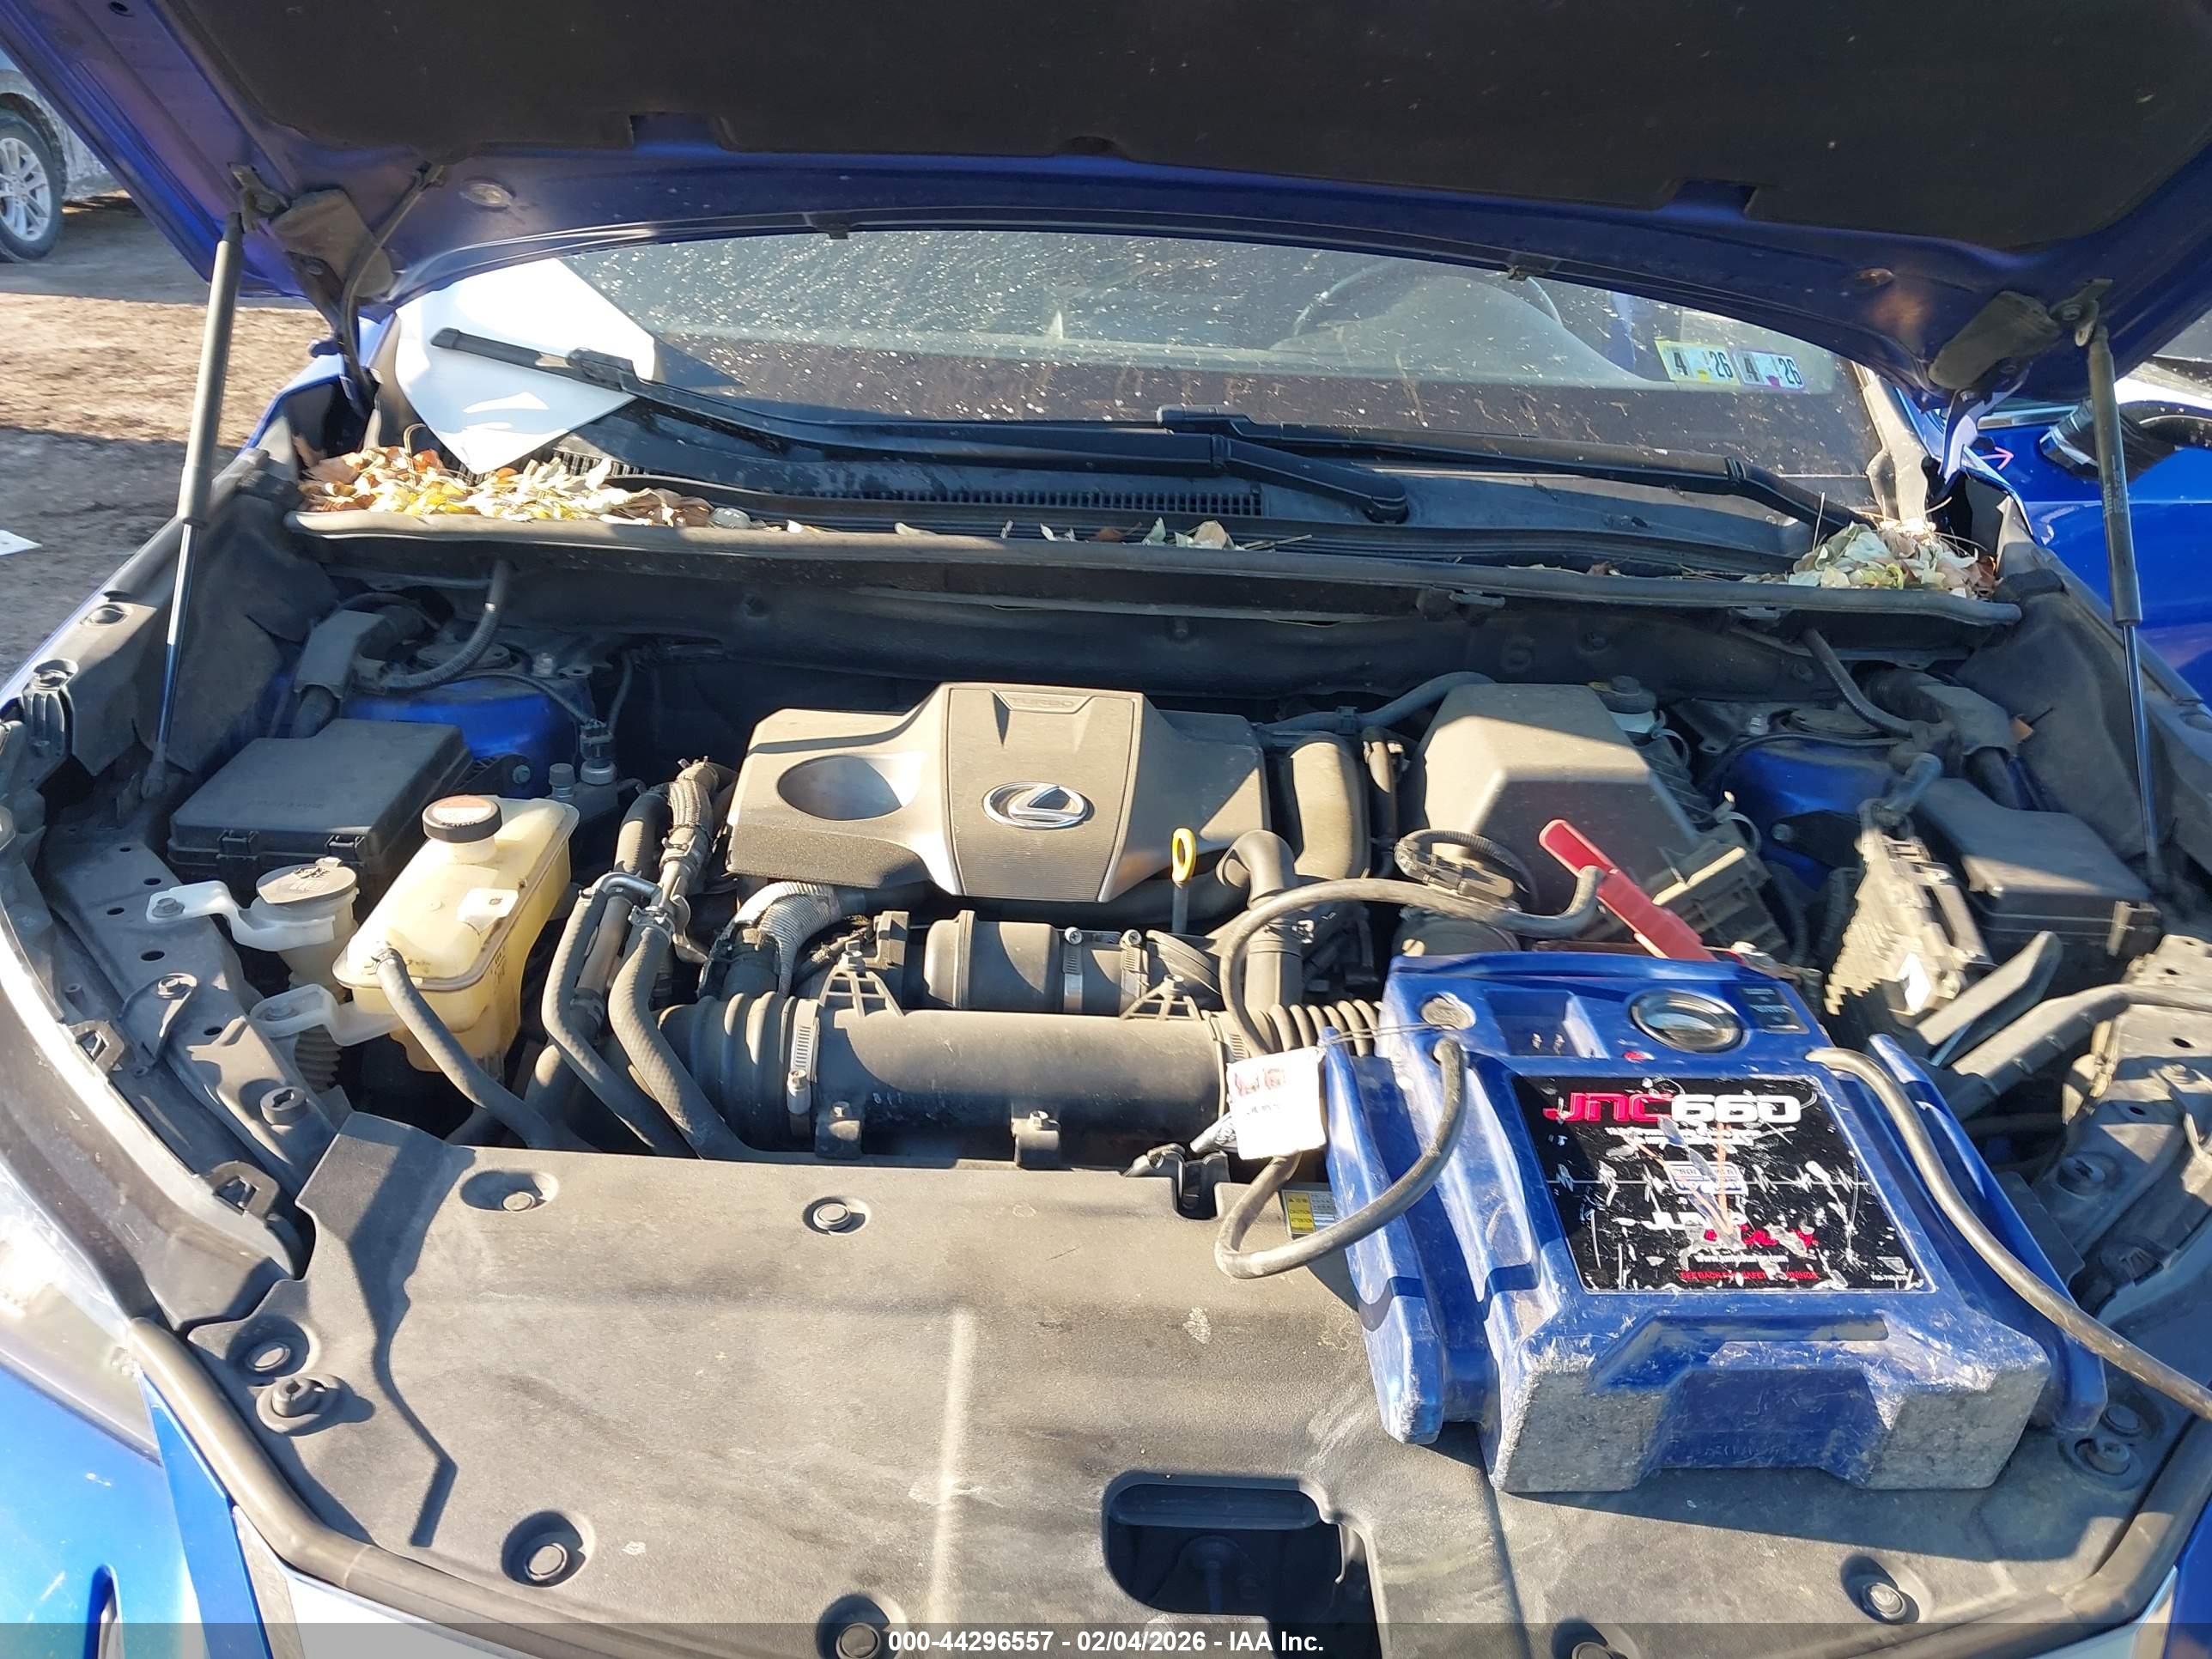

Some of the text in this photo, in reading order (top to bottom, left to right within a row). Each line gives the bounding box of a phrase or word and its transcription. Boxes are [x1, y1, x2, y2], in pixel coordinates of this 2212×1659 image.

[1673, 350, 1734, 379] 4 26
[1743, 357, 1802, 386] 4 26
